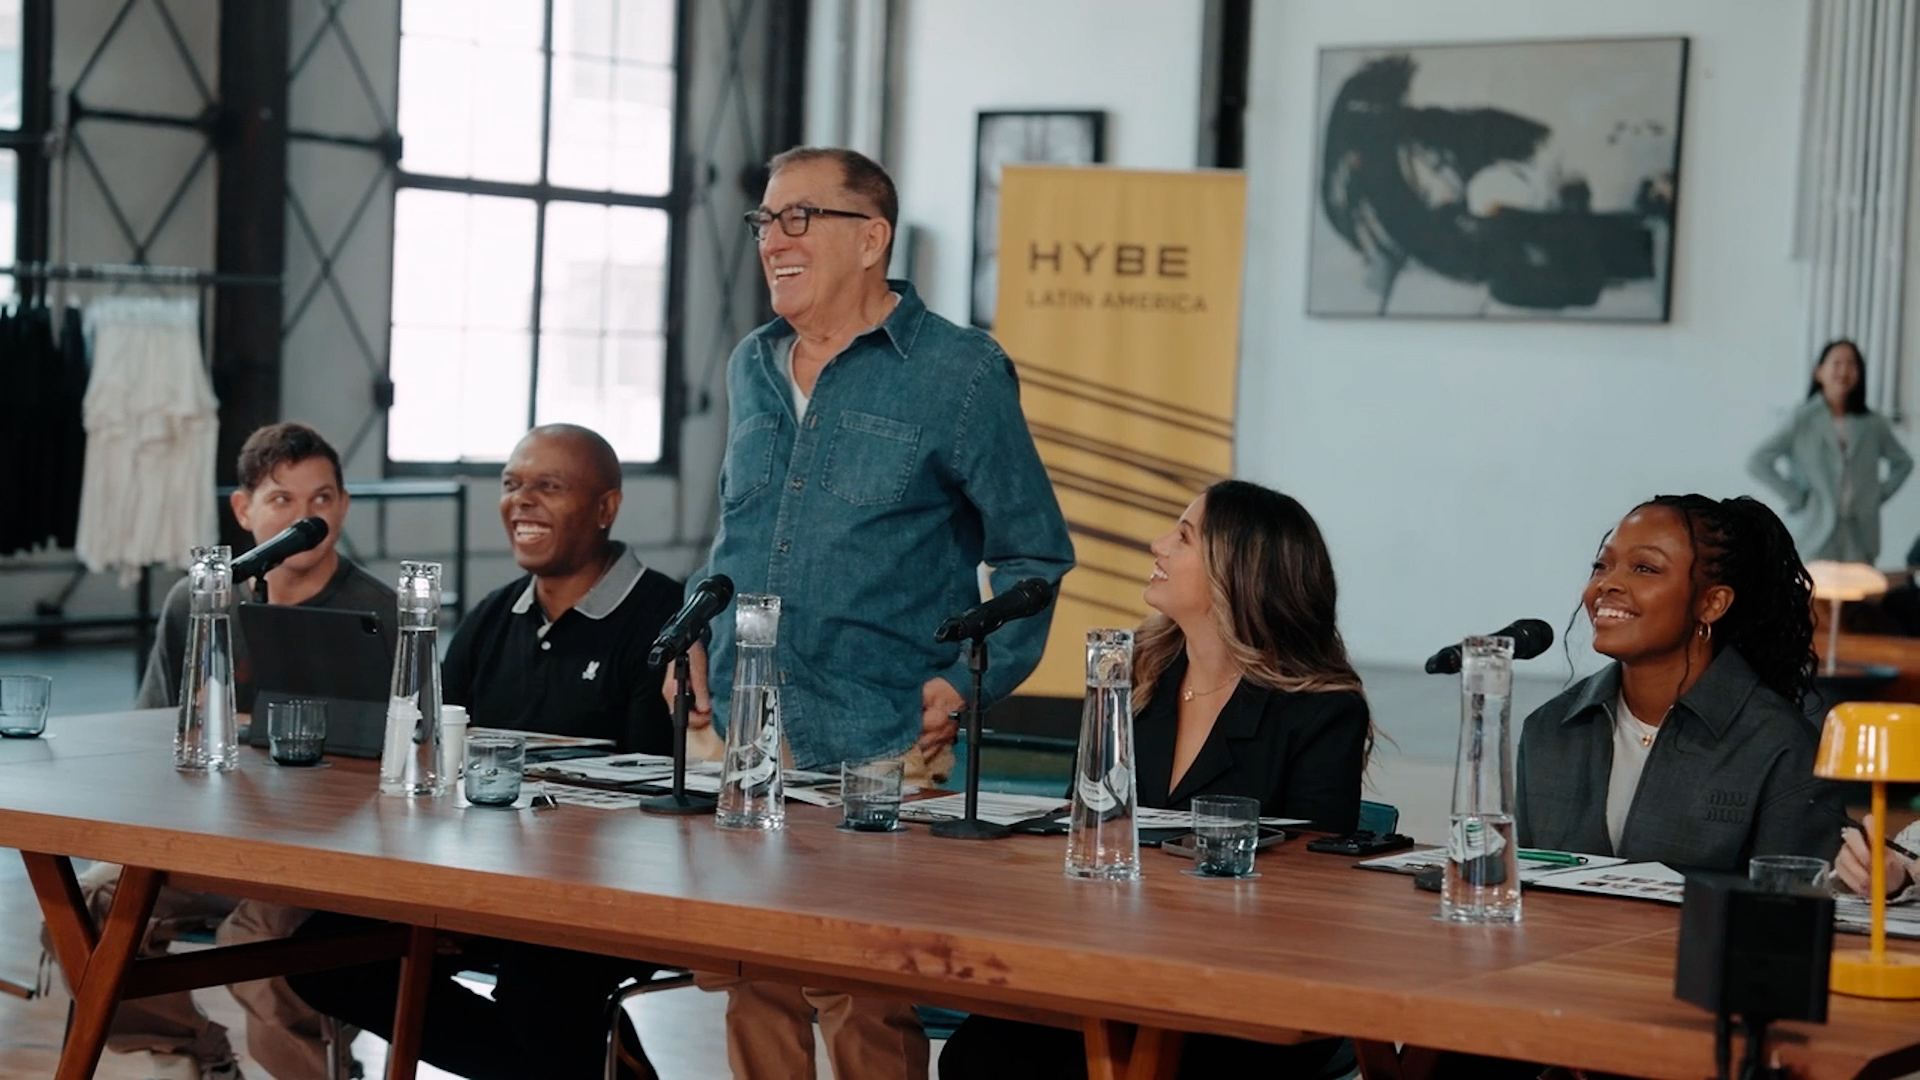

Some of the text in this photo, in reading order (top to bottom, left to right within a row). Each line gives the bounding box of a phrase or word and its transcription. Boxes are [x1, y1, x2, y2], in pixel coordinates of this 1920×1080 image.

[1028, 241, 1190, 279] HYBE
[1027, 289, 1208, 314] LATIN AMERICA
